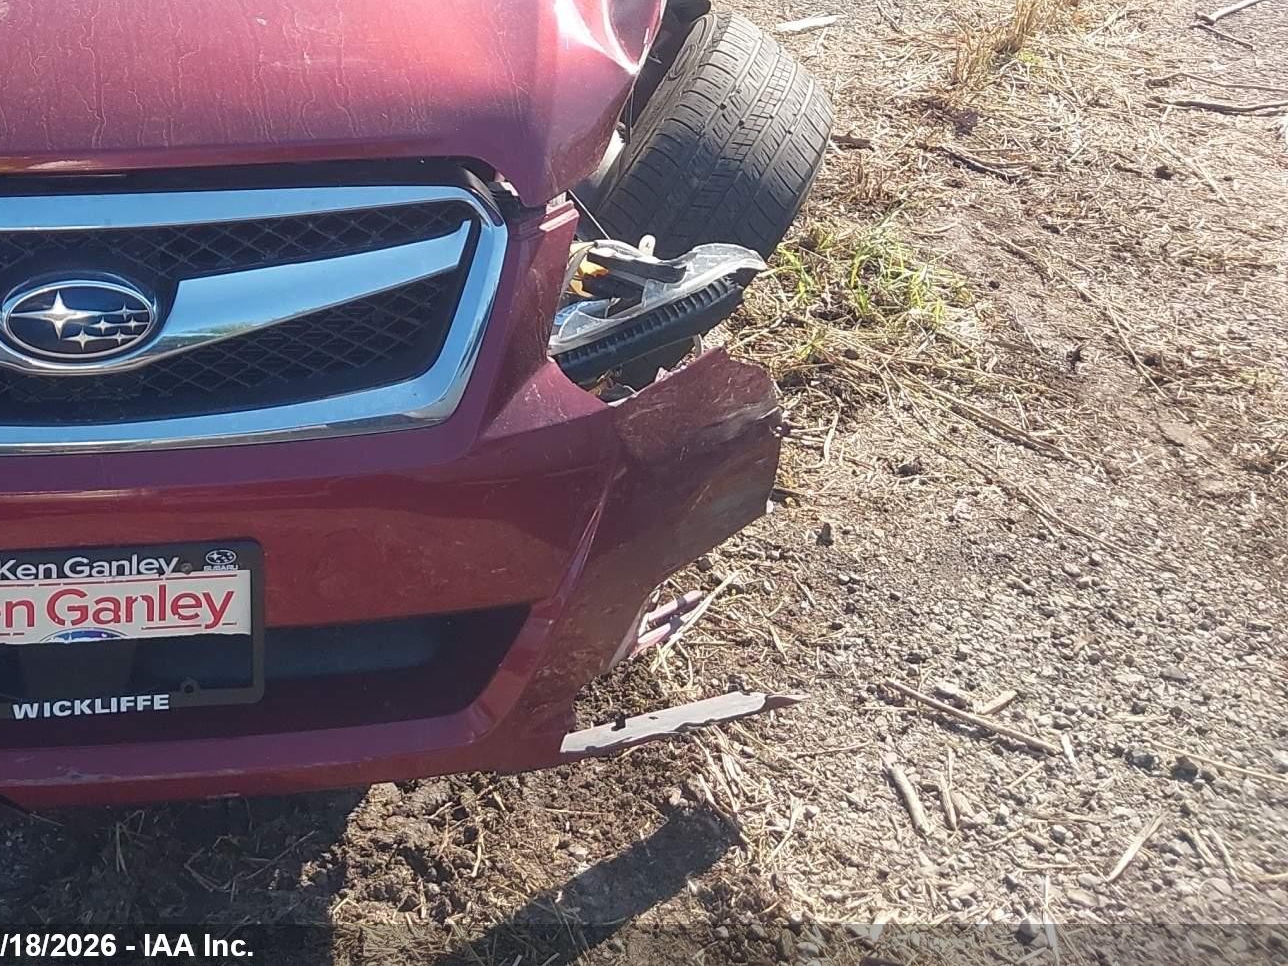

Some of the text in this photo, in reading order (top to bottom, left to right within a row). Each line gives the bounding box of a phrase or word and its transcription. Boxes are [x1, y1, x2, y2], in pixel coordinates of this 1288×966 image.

[63, 553, 179, 579] Ganley
[46, 584, 235, 629] Ganley
[13, 693, 170, 720] WICKLIFFE
